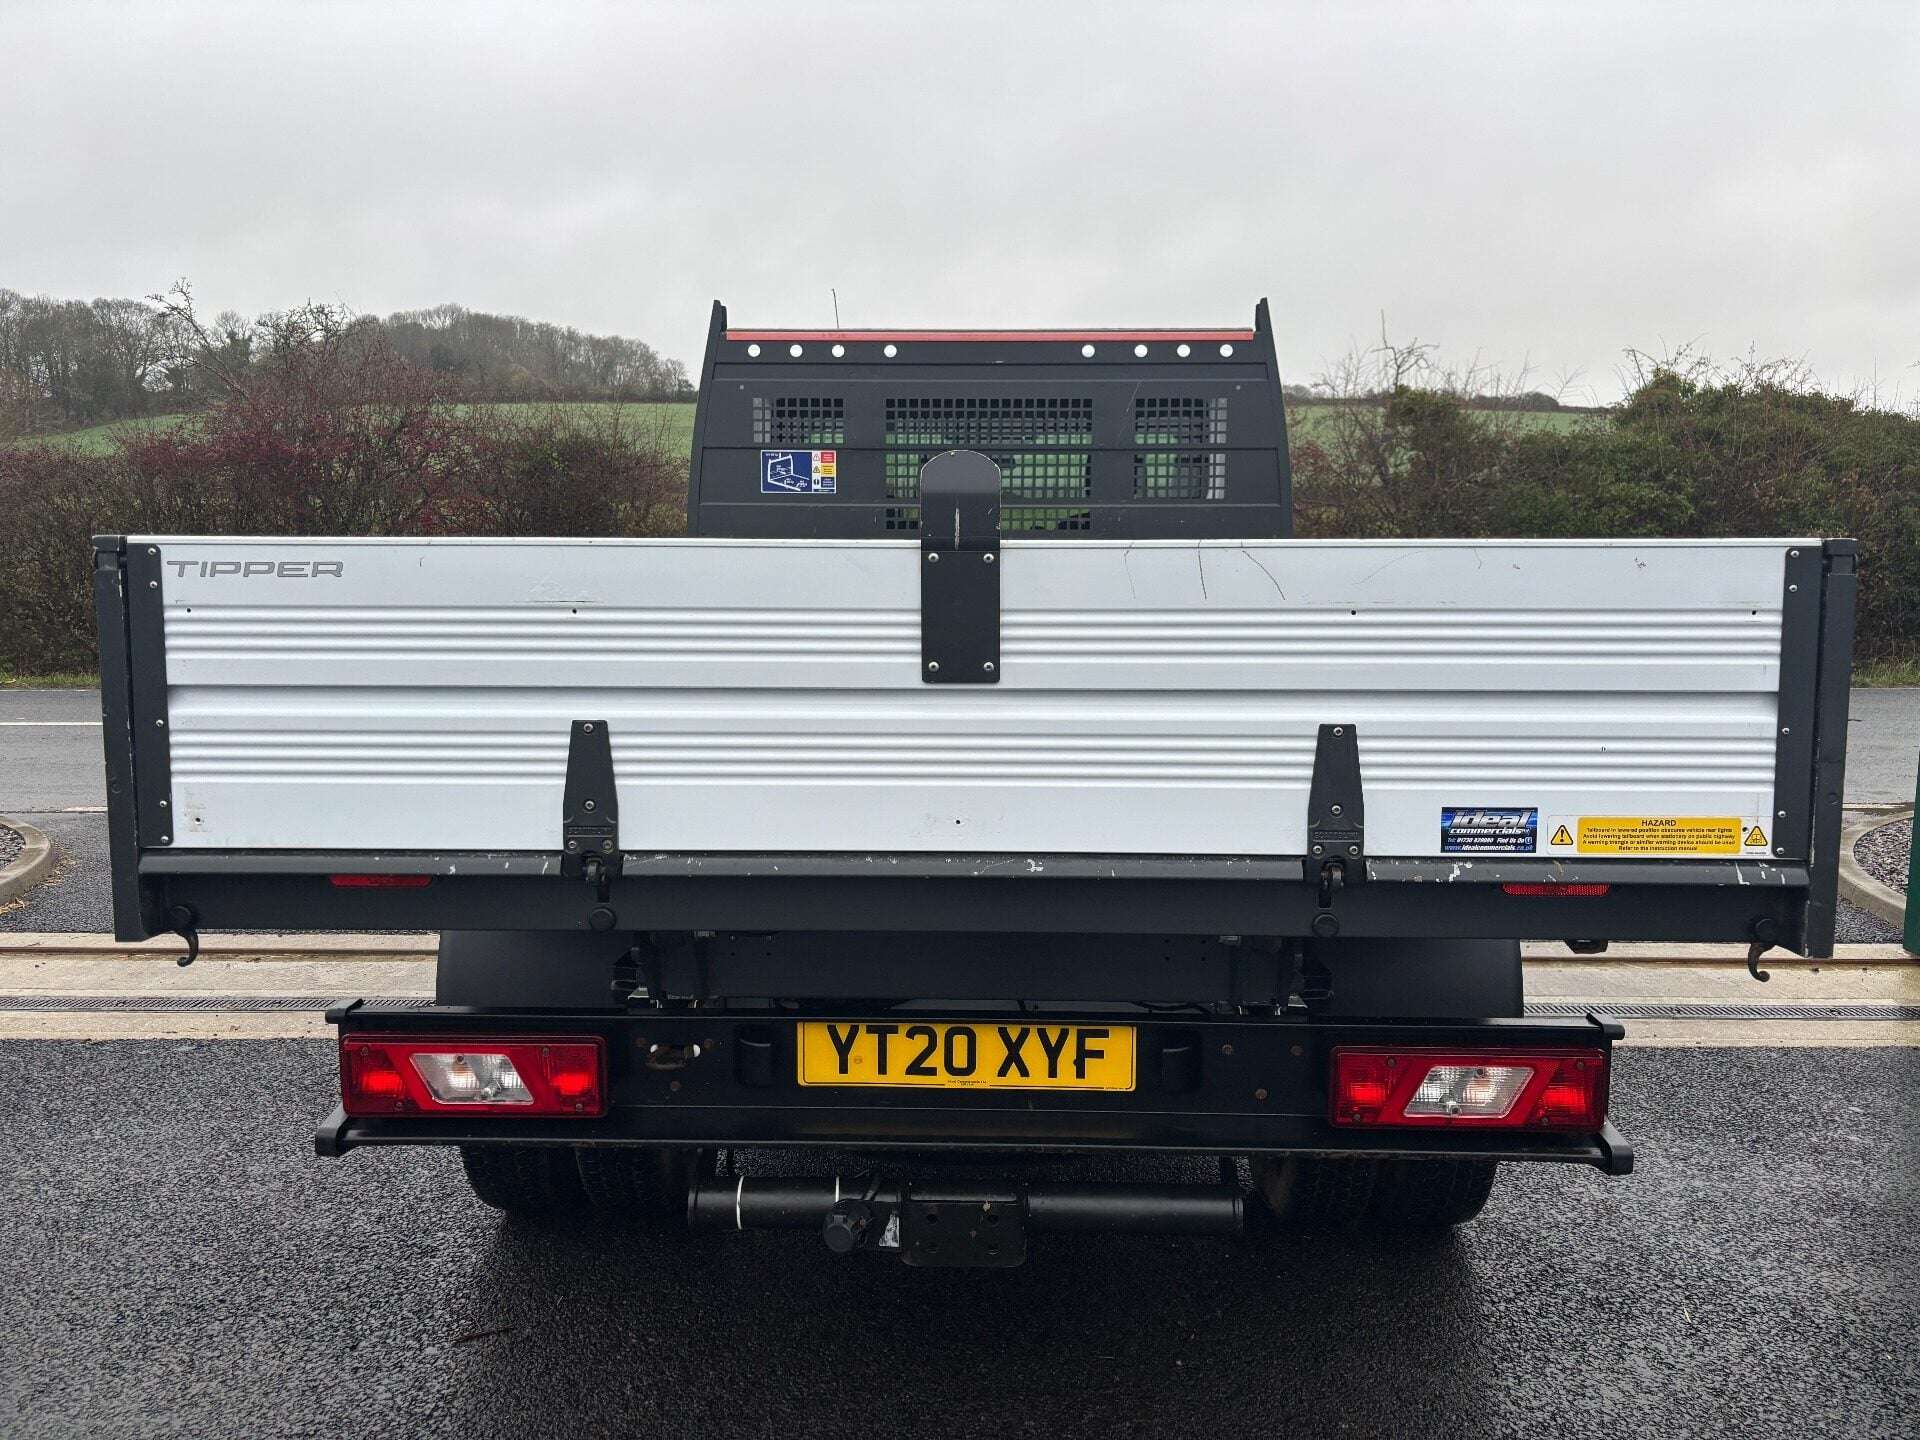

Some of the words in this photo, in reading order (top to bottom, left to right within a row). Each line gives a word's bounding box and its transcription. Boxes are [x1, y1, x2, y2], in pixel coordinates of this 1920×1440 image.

[166, 561, 344, 578] TIPPER
[1450, 809, 1534, 828] ideal
[826, 1024, 977, 1077] YT20
[996, 1027, 1111, 1080] XYF
